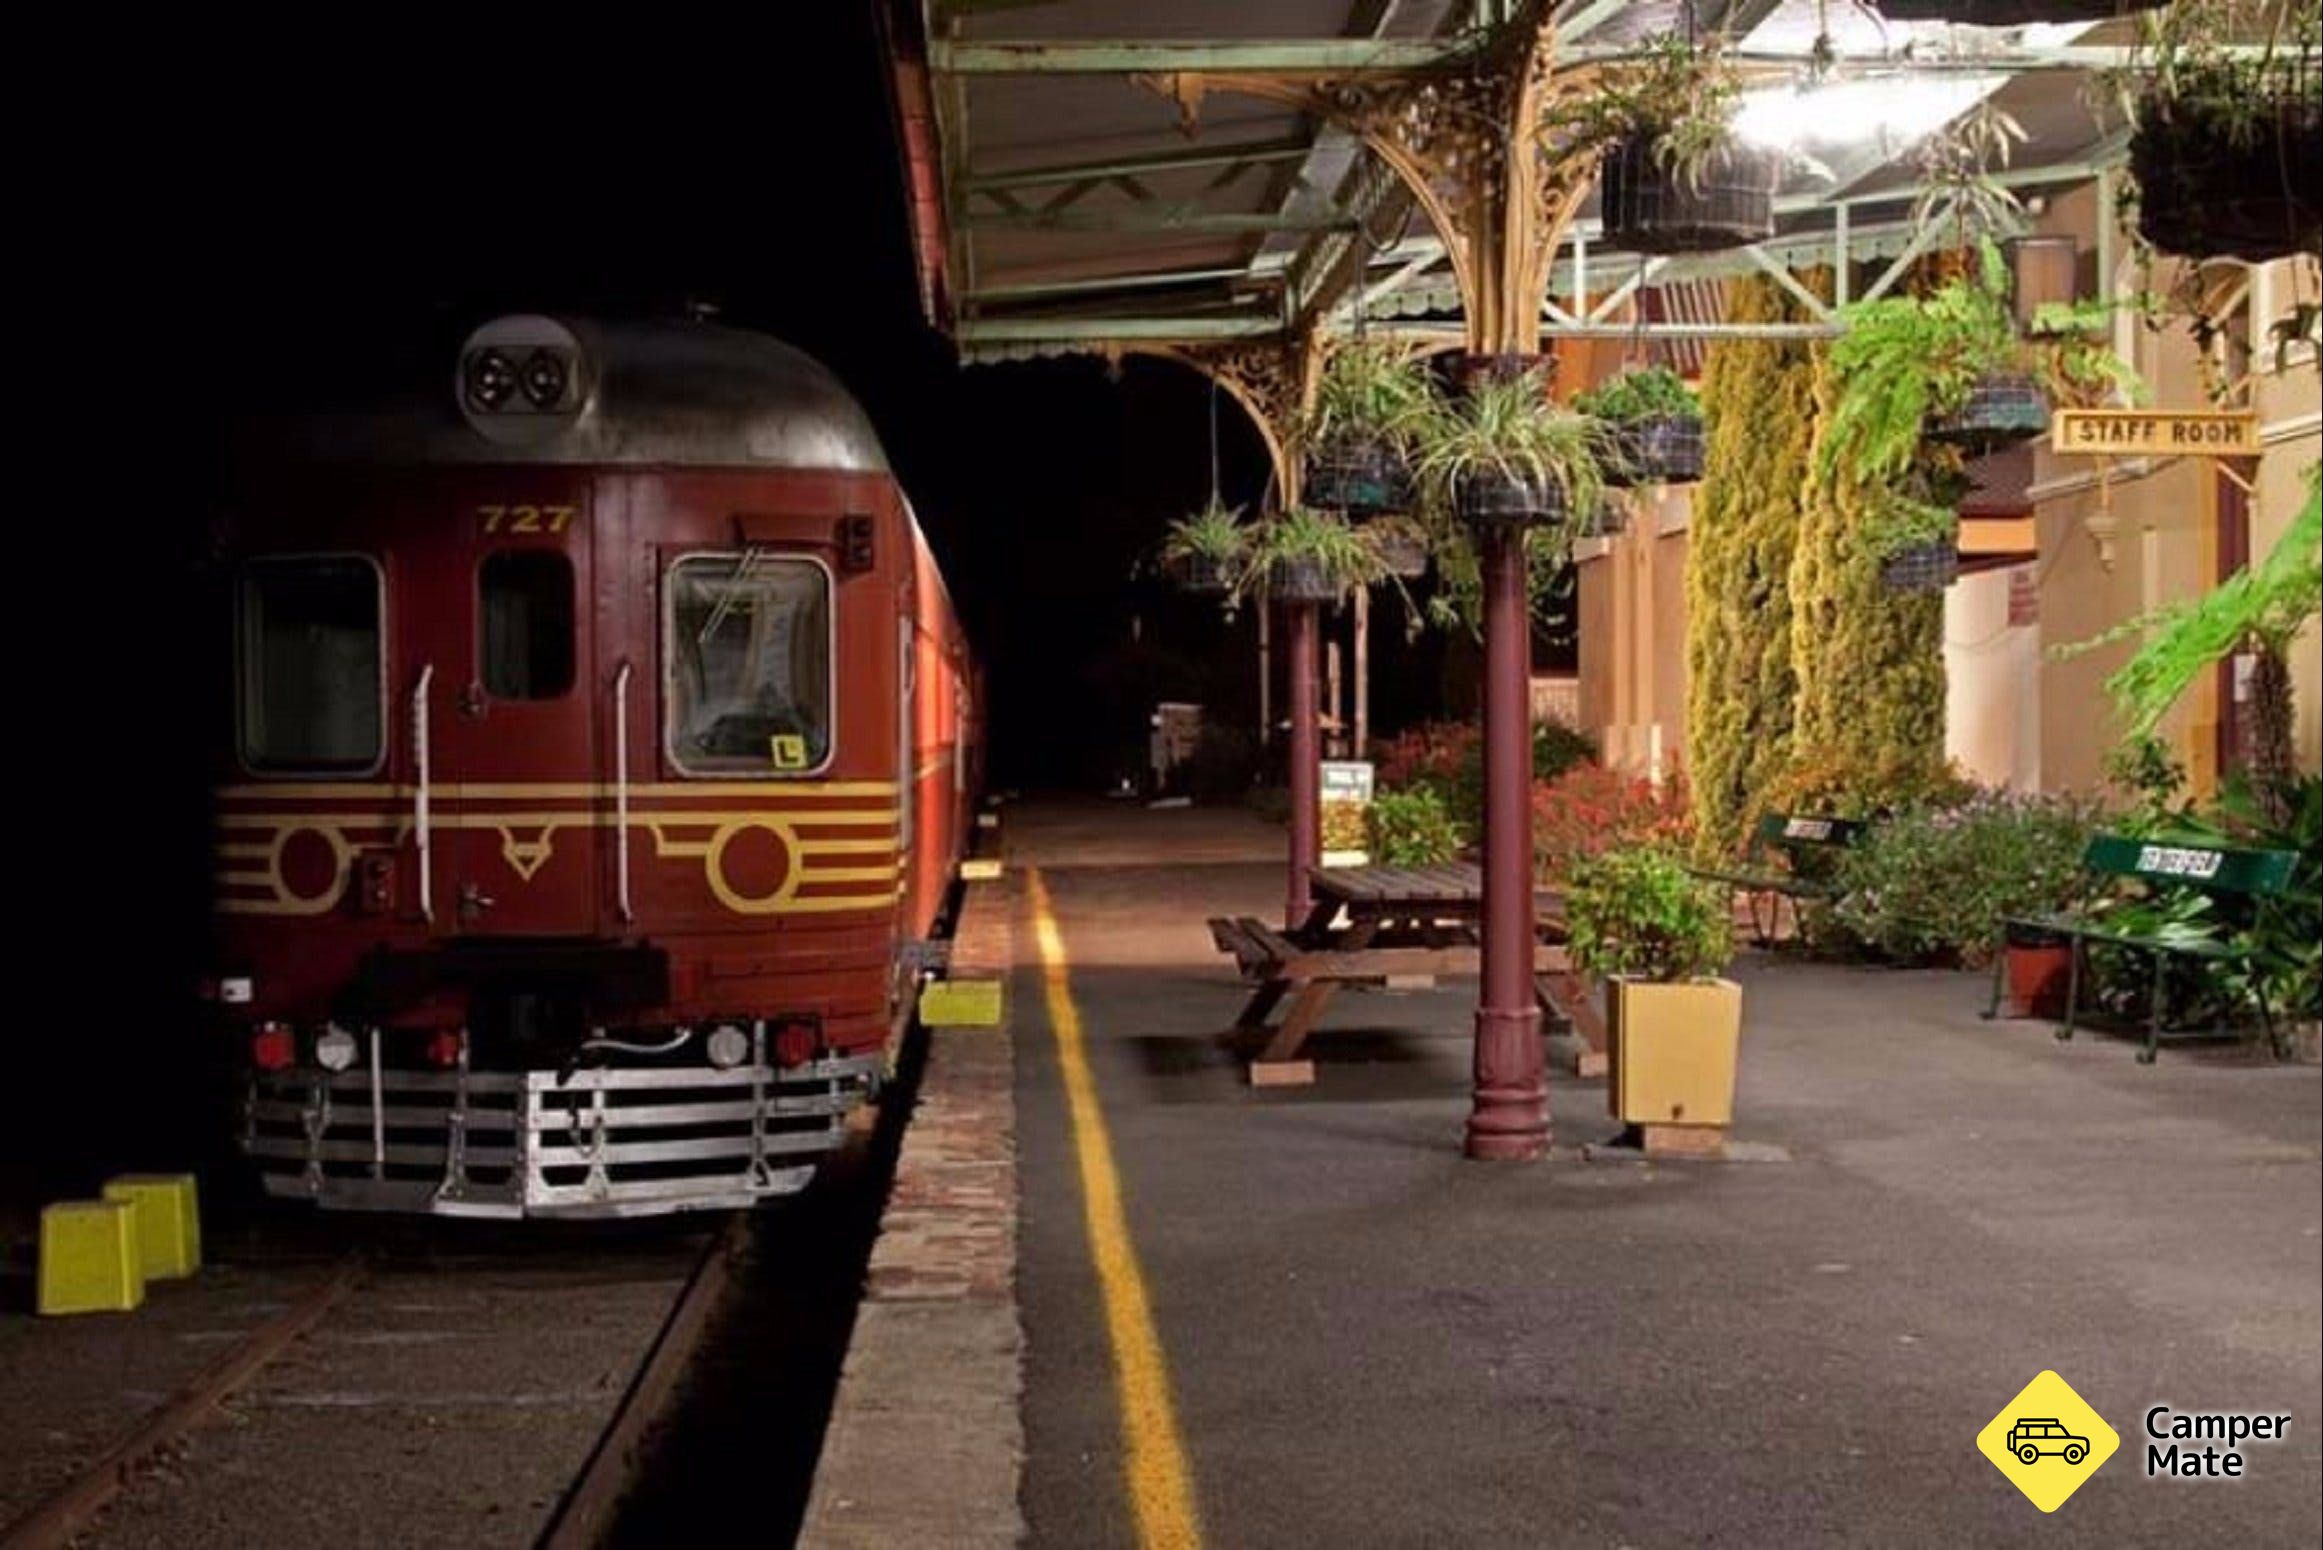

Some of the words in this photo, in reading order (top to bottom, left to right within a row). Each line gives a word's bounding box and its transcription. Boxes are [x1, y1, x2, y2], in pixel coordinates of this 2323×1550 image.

[2079, 420, 2157, 442] STAFF
[2173, 421, 2243, 443] ROOM
[477, 506, 575, 533] 727
[778, 740, 799, 762] L
